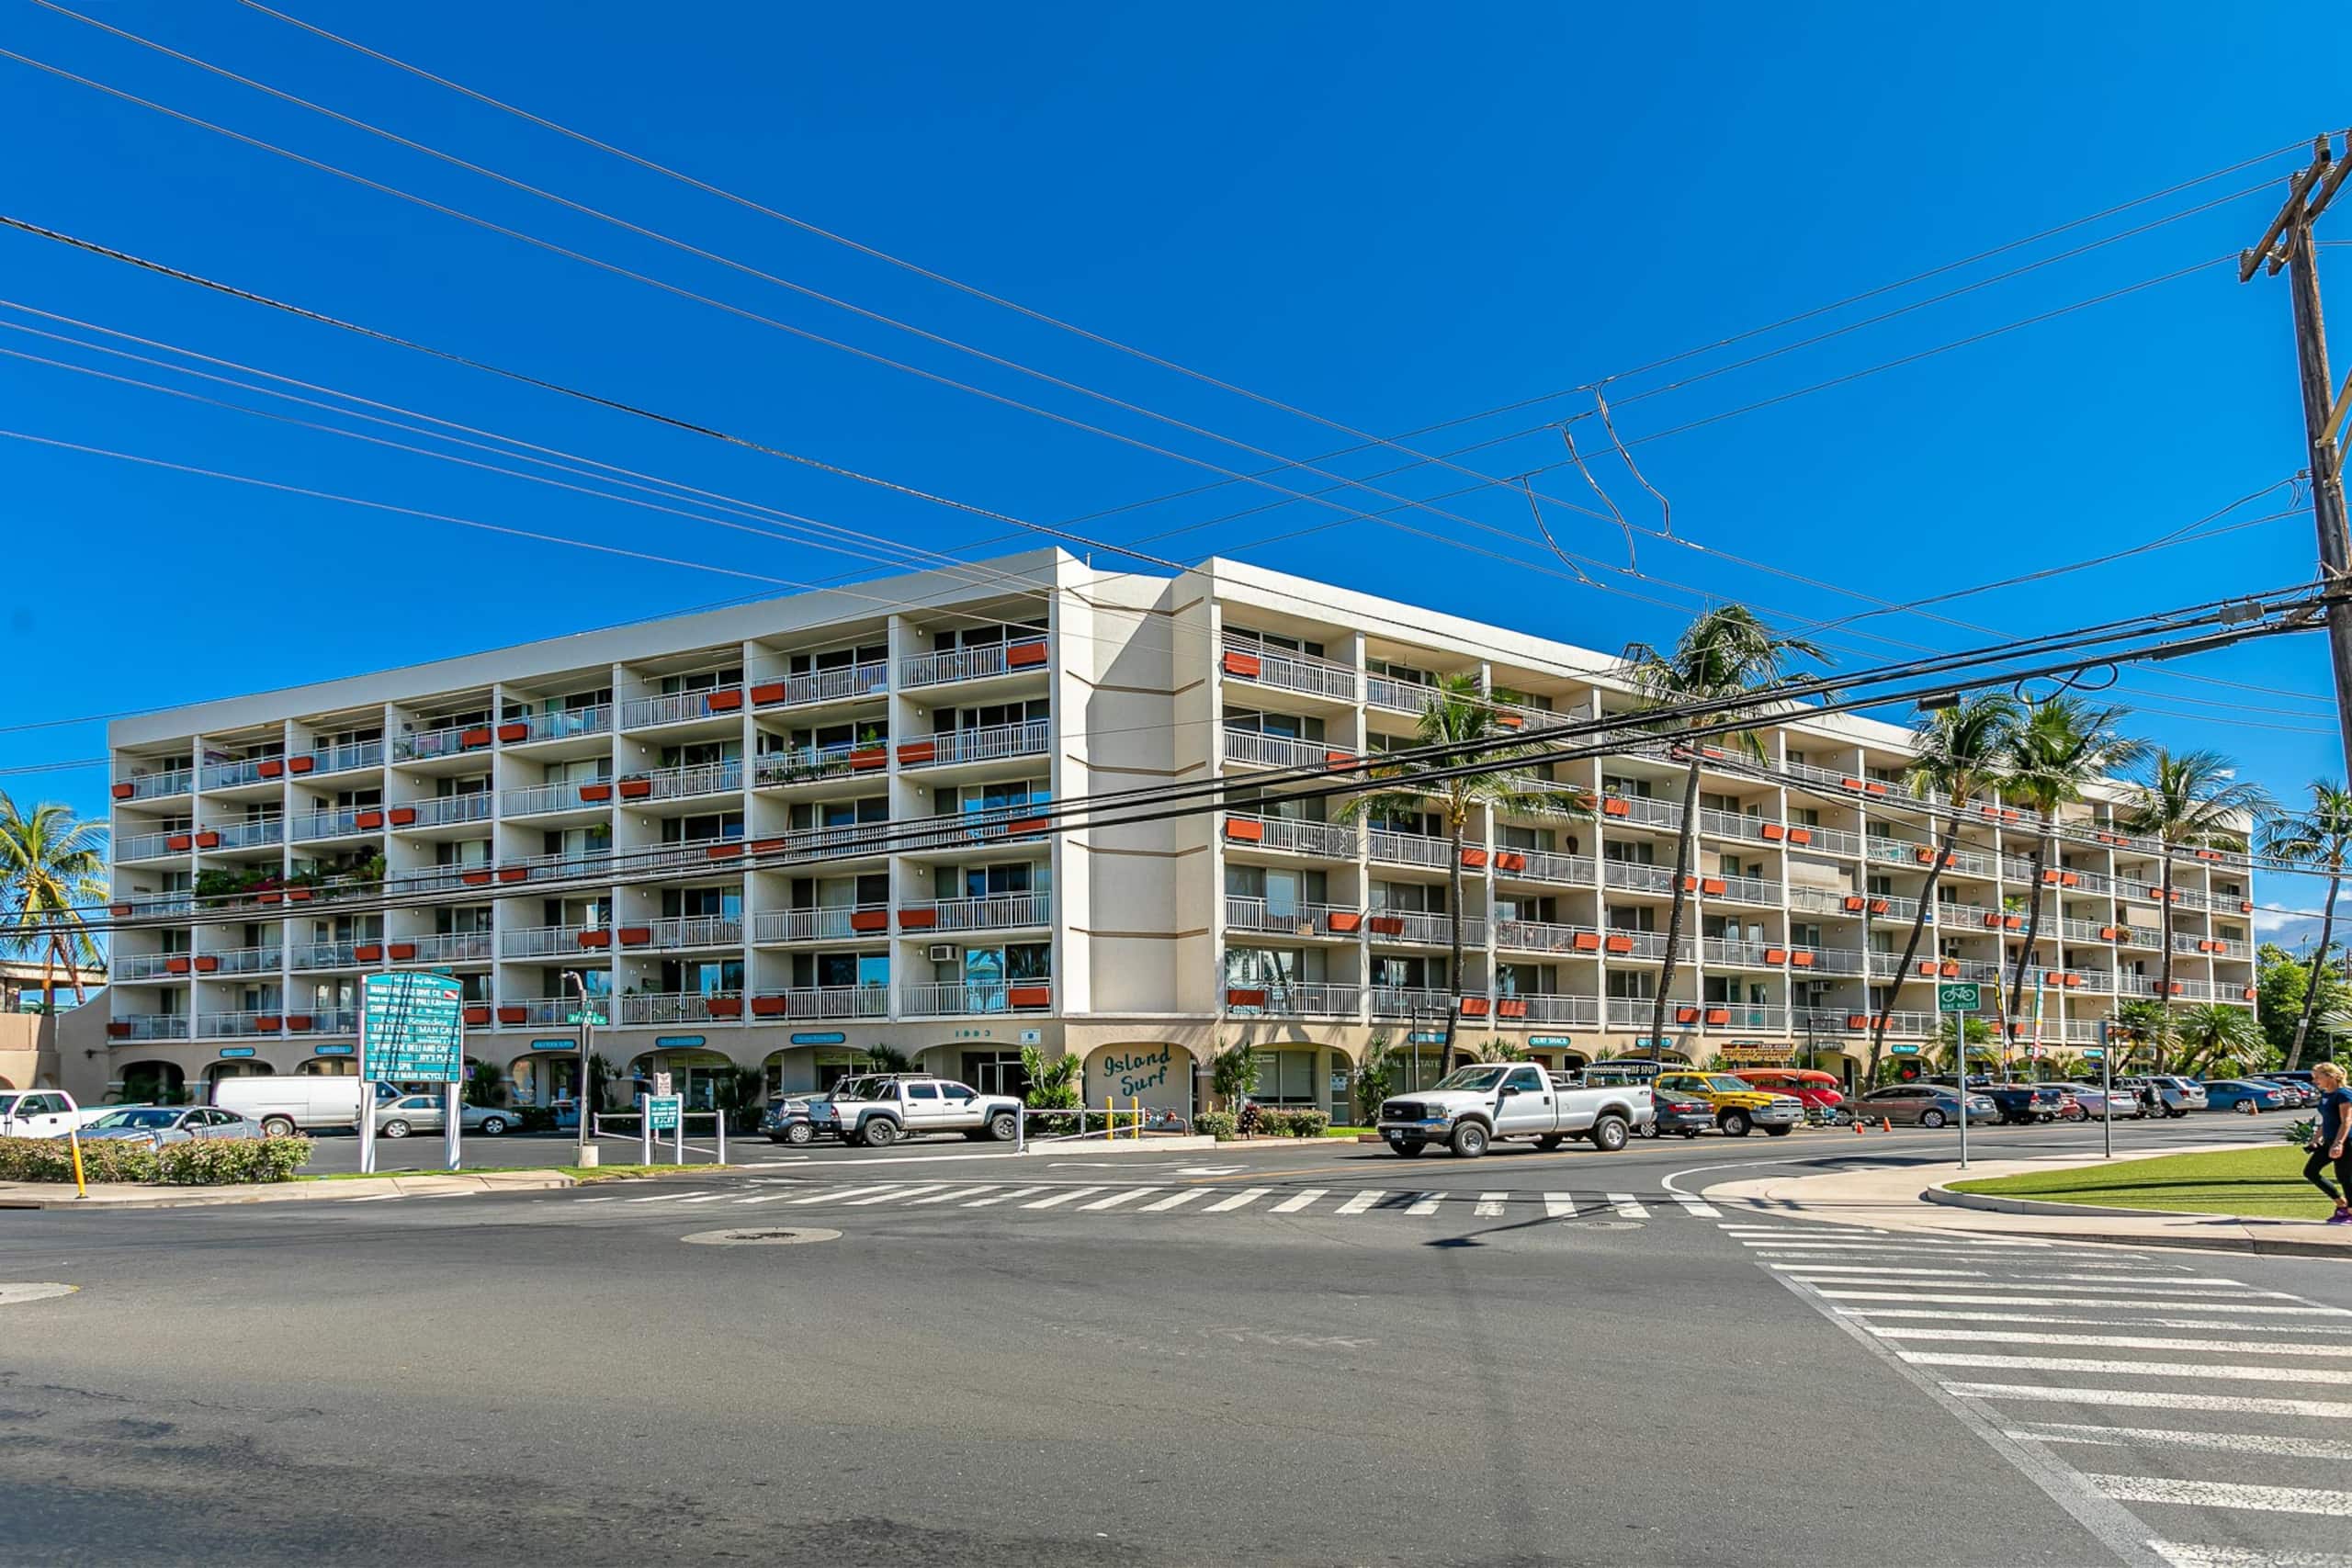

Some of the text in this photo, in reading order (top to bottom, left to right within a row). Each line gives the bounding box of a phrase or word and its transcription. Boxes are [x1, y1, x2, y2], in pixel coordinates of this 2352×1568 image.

[373, 1024, 408, 1033] TATTOO
[1532, 1036, 1568, 1044] SURF SHACK
[1103, 1043, 1172, 1077] Island
[1407, 1060, 1442, 1068] ETATE
[1641, 1066, 1657, 1074] SPOT
[1121, 1066, 1168, 1097] Surf
[653, 1116, 675, 1124] EXIT
